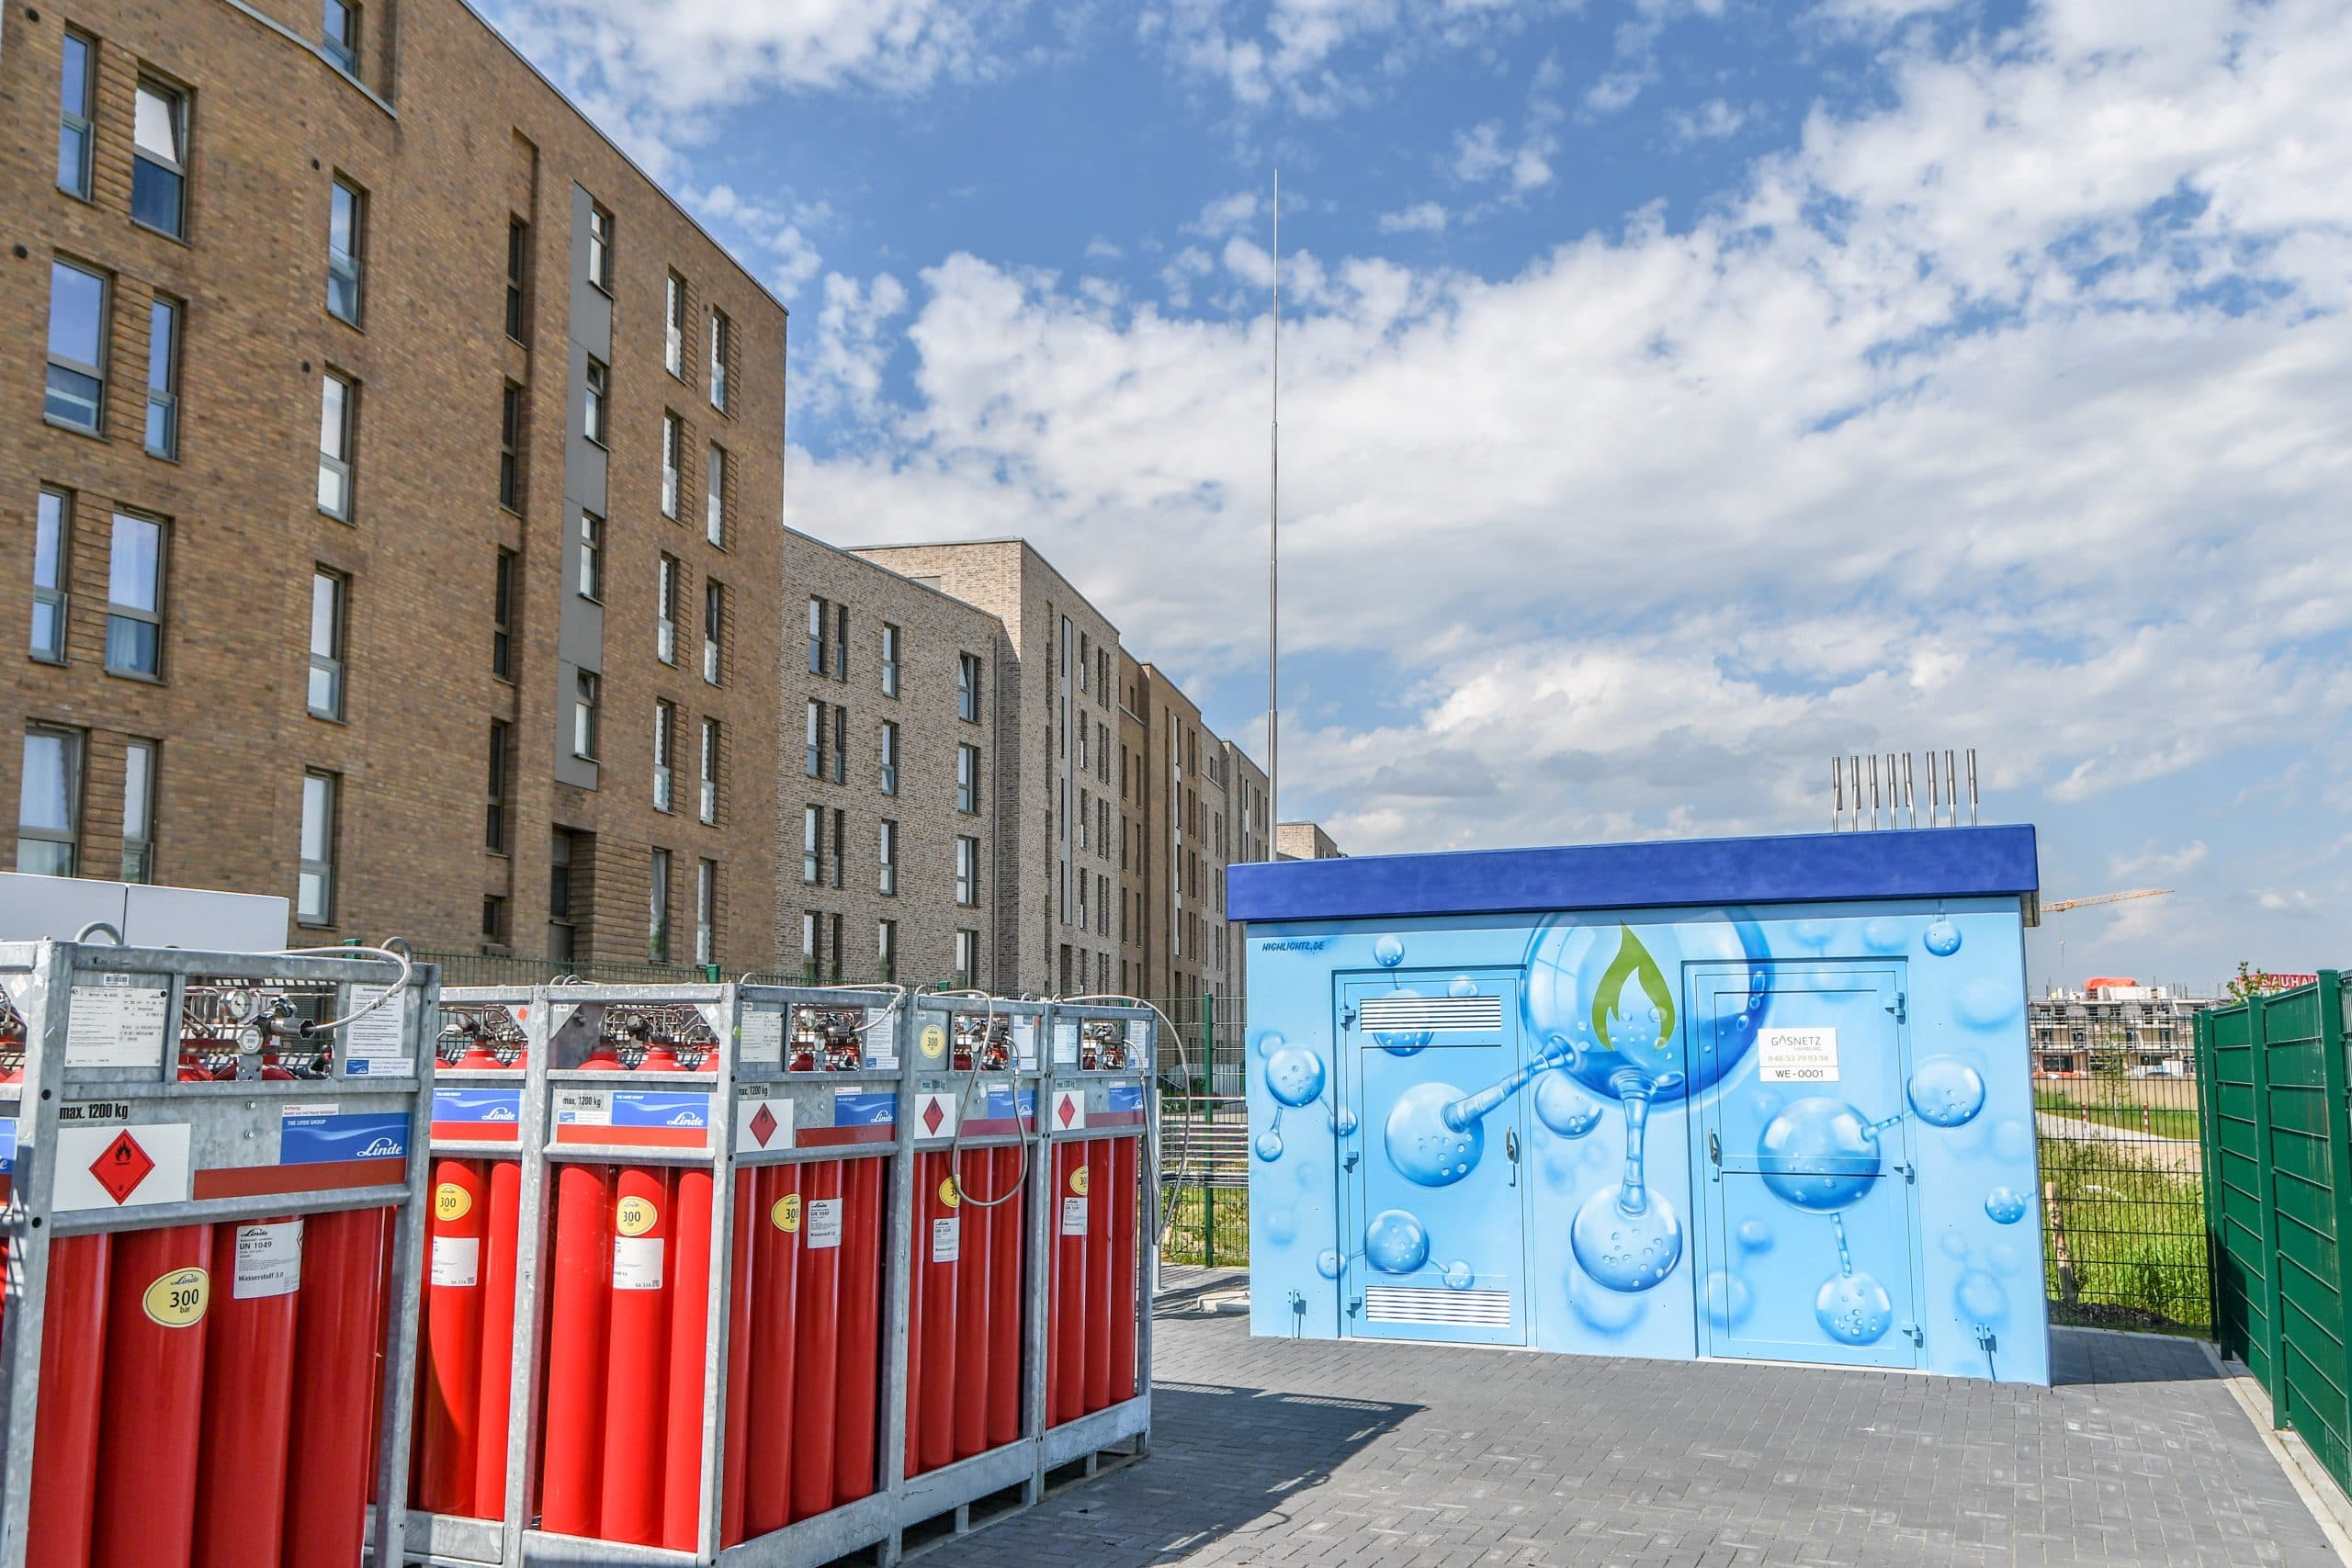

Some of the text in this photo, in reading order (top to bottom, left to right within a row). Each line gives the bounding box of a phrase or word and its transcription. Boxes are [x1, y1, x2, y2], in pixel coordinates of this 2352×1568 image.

[1771, 1035, 1821, 1045] GASNETZ
[750, 1086, 761, 1095] 1200
[579, 1097, 592, 1106] 1200
[594, 1097, 601, 1108] kg
[59, 1103, 129, 1120] max. 1200 kg
[481, 1107, 514, 1121] Linde
[871, 1110, 893, 1123] Linde
[666, 1111, 704, 1126] Linde
[356, 1137, 402, 1157] Linde
[440, 1198, 456, 1207] 300
[623, 1211, 641, 1222] 300
[241, 1227, 268, 1237] Linde
[254, 1241, 272, 1249] 1049
[170, 1273, 198, 1286] Linde
[239, 1273, 274, 1281] Wasserstoff
[169, 1288, 198, 1308] 300
